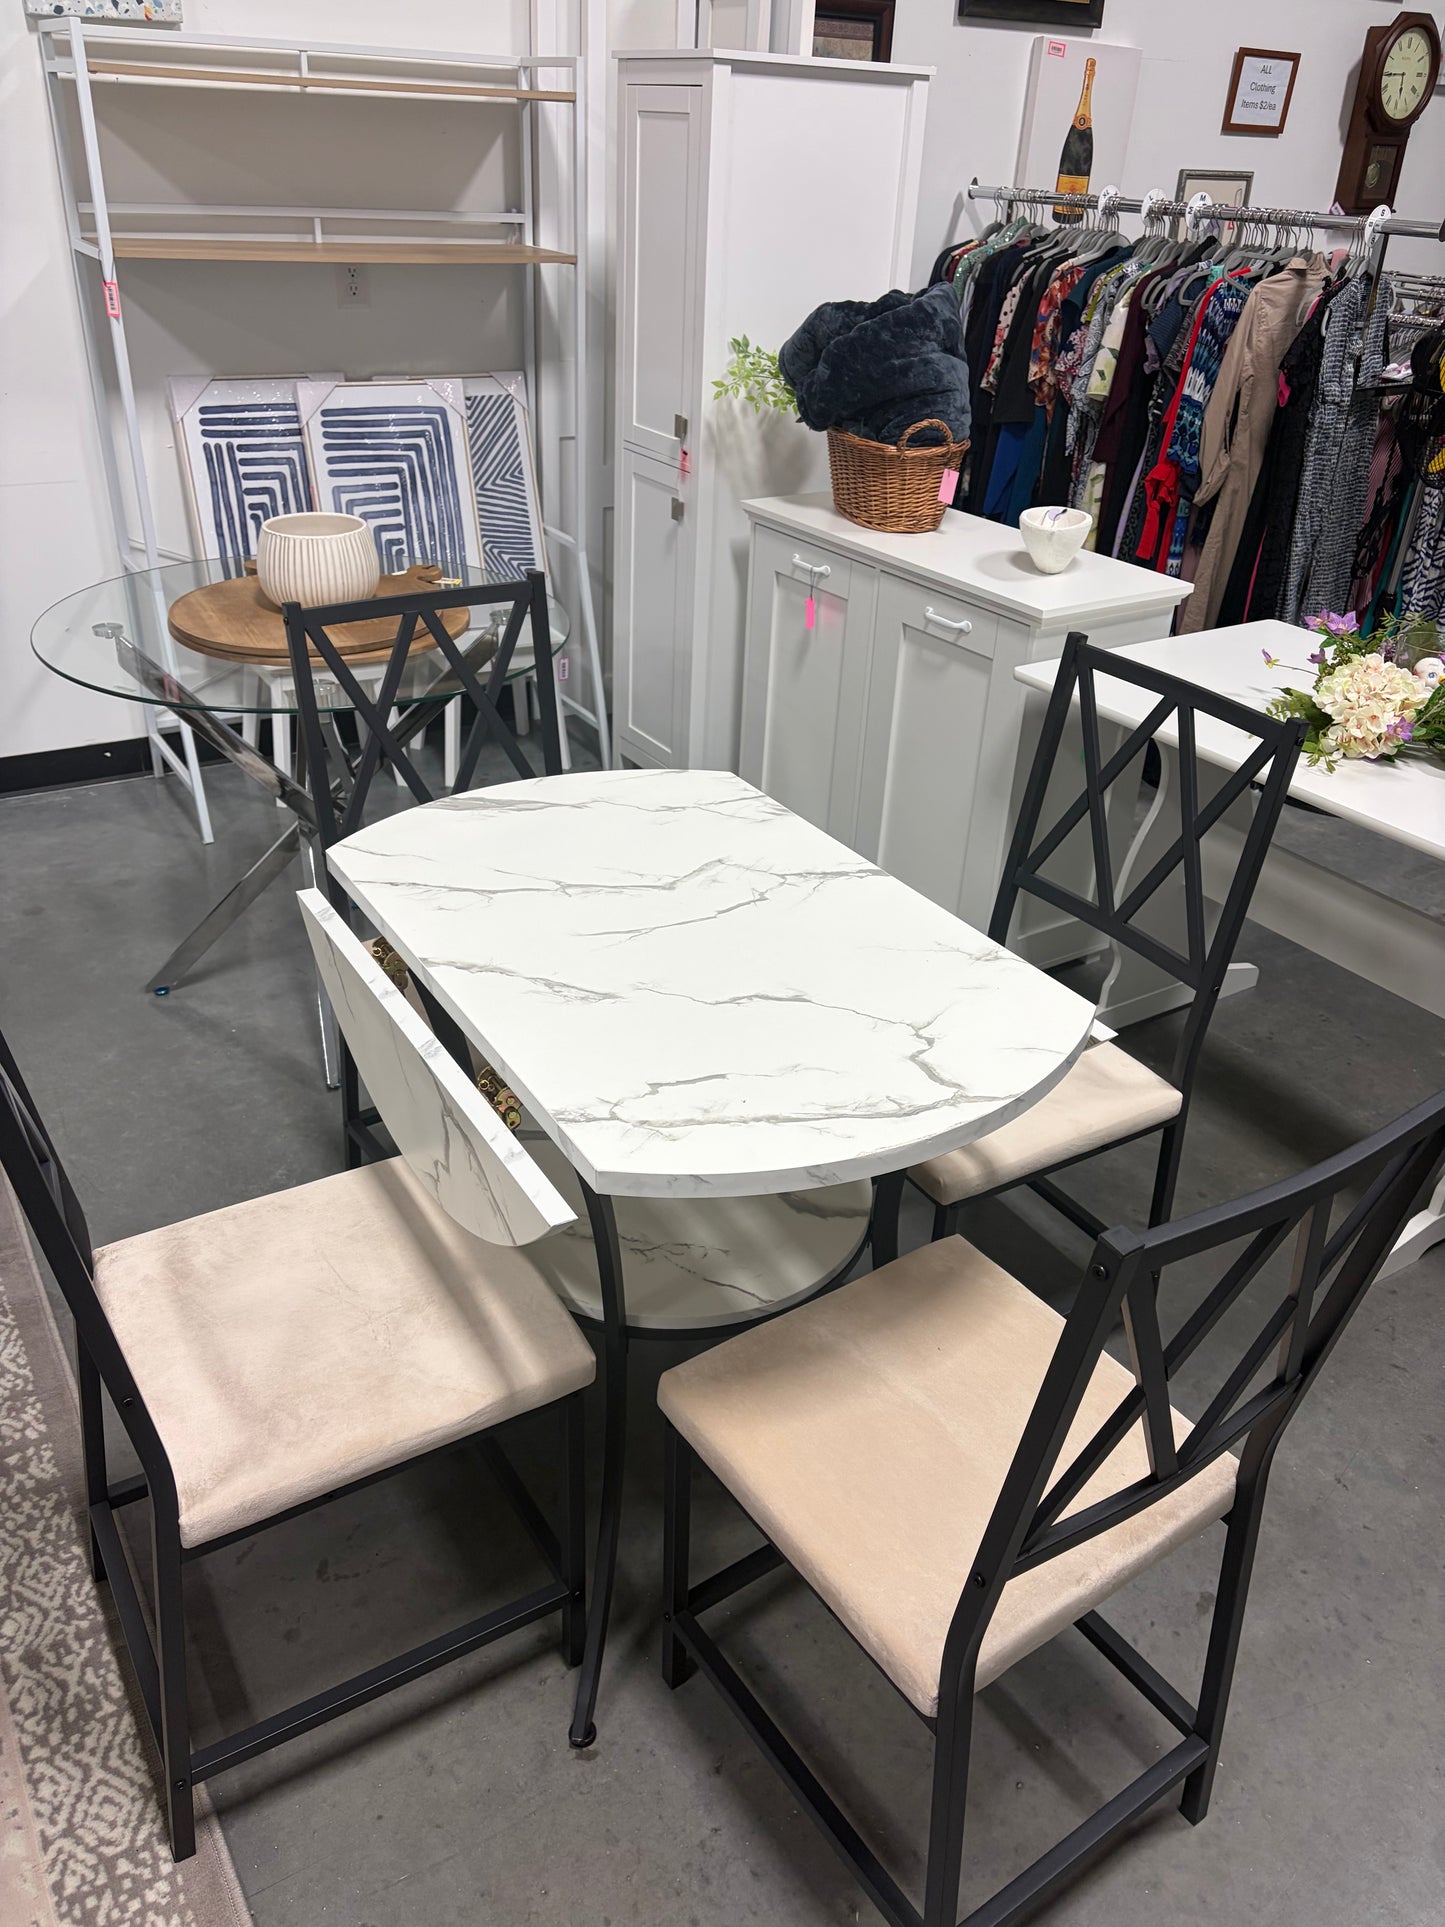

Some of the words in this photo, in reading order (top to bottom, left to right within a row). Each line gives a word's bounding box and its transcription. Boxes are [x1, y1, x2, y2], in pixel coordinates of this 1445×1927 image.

[1260, 65, 1272, 75] ALL
[1250, 82, 1276, 94] Clothing
[1241, 99, 1258, 109] Items
[1259, 100, 1276, 110] $2/ea
[1200, 194, 1207, 202] M
[1380, 209, 1386, 217] S
